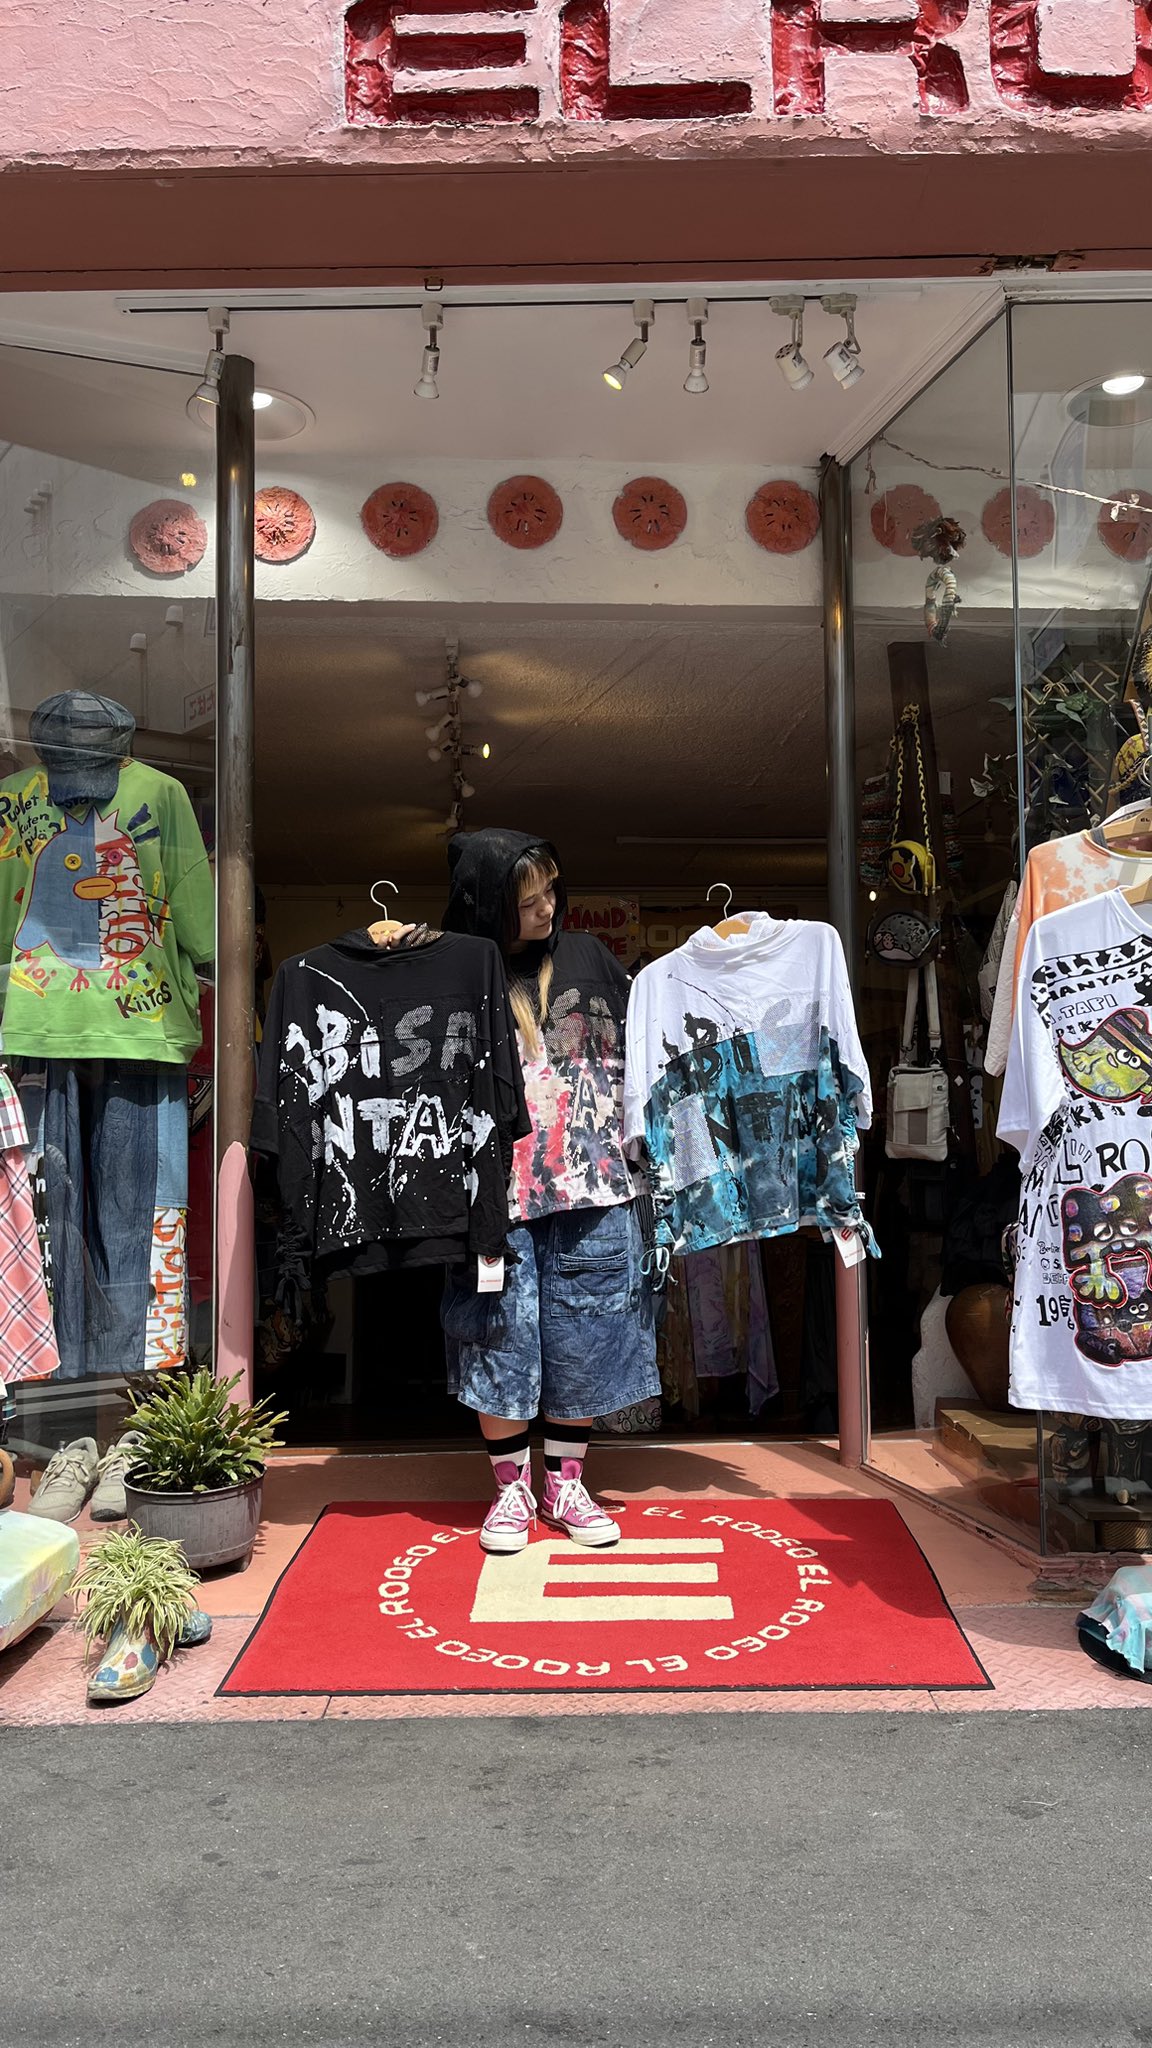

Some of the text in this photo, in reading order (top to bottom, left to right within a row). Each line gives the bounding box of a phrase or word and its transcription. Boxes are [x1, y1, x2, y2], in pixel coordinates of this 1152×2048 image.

[562, 905, 627, 930] HAND
[431, 1528, 481, 1544] EL
[642, 1506, 687, 1520] EL
[700, 1515, 819, 1559] RODEO
[378, 1545, 440, 1640] EL RODEO
[704, 1564, 832, 1661] EL RODEO
[434, 1639, 689, 1677] EL RODEO
